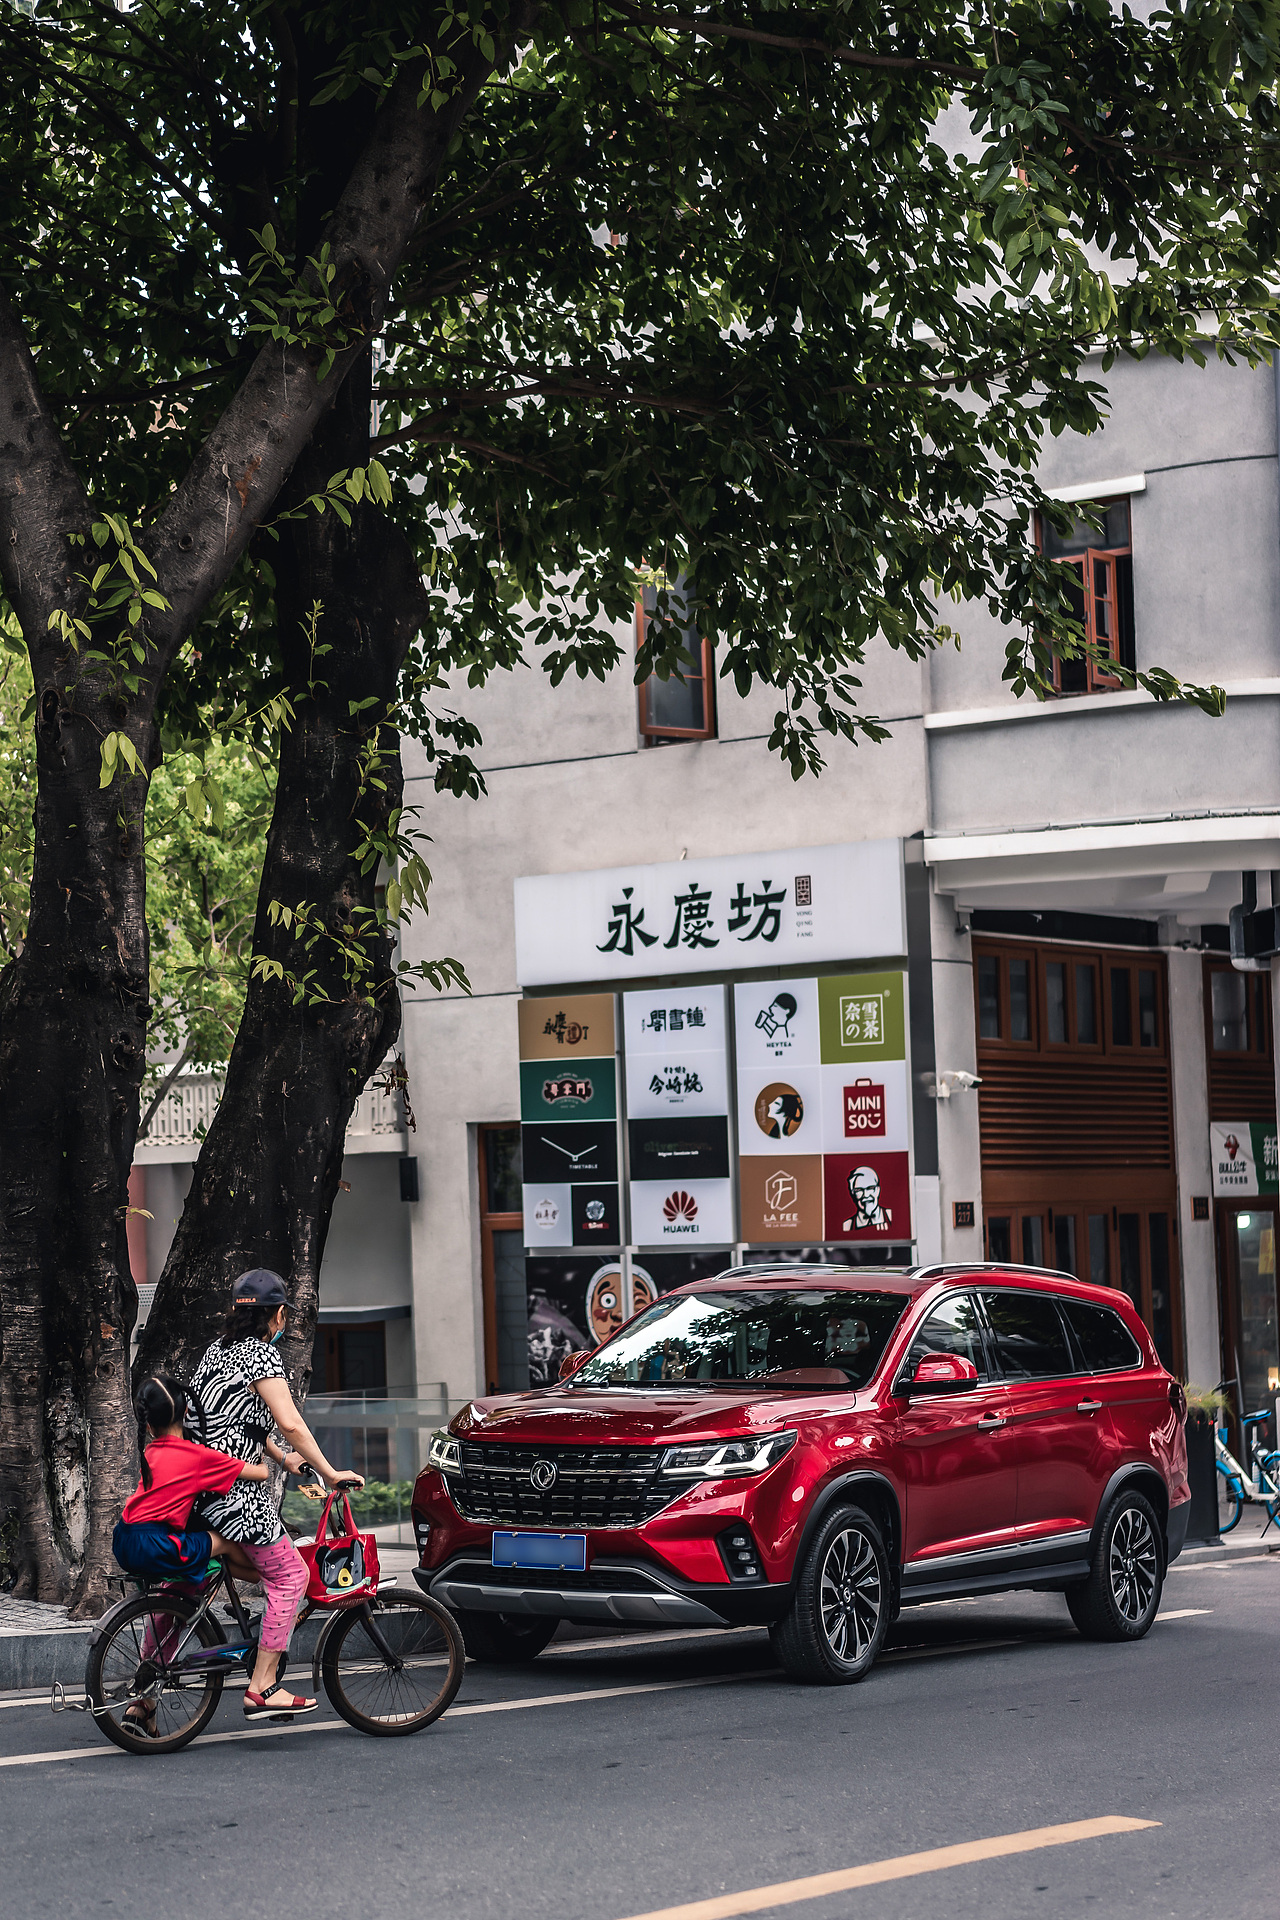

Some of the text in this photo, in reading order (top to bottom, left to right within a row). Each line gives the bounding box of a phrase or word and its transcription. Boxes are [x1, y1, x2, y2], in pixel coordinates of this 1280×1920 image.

[596, 880, 787, 956] 永慶坊
[763, 1213, 799, 1222] LA FEE
[958, 1211, 971, 1223] 217
[663, 1225, 699, 1233] HUAWEI
